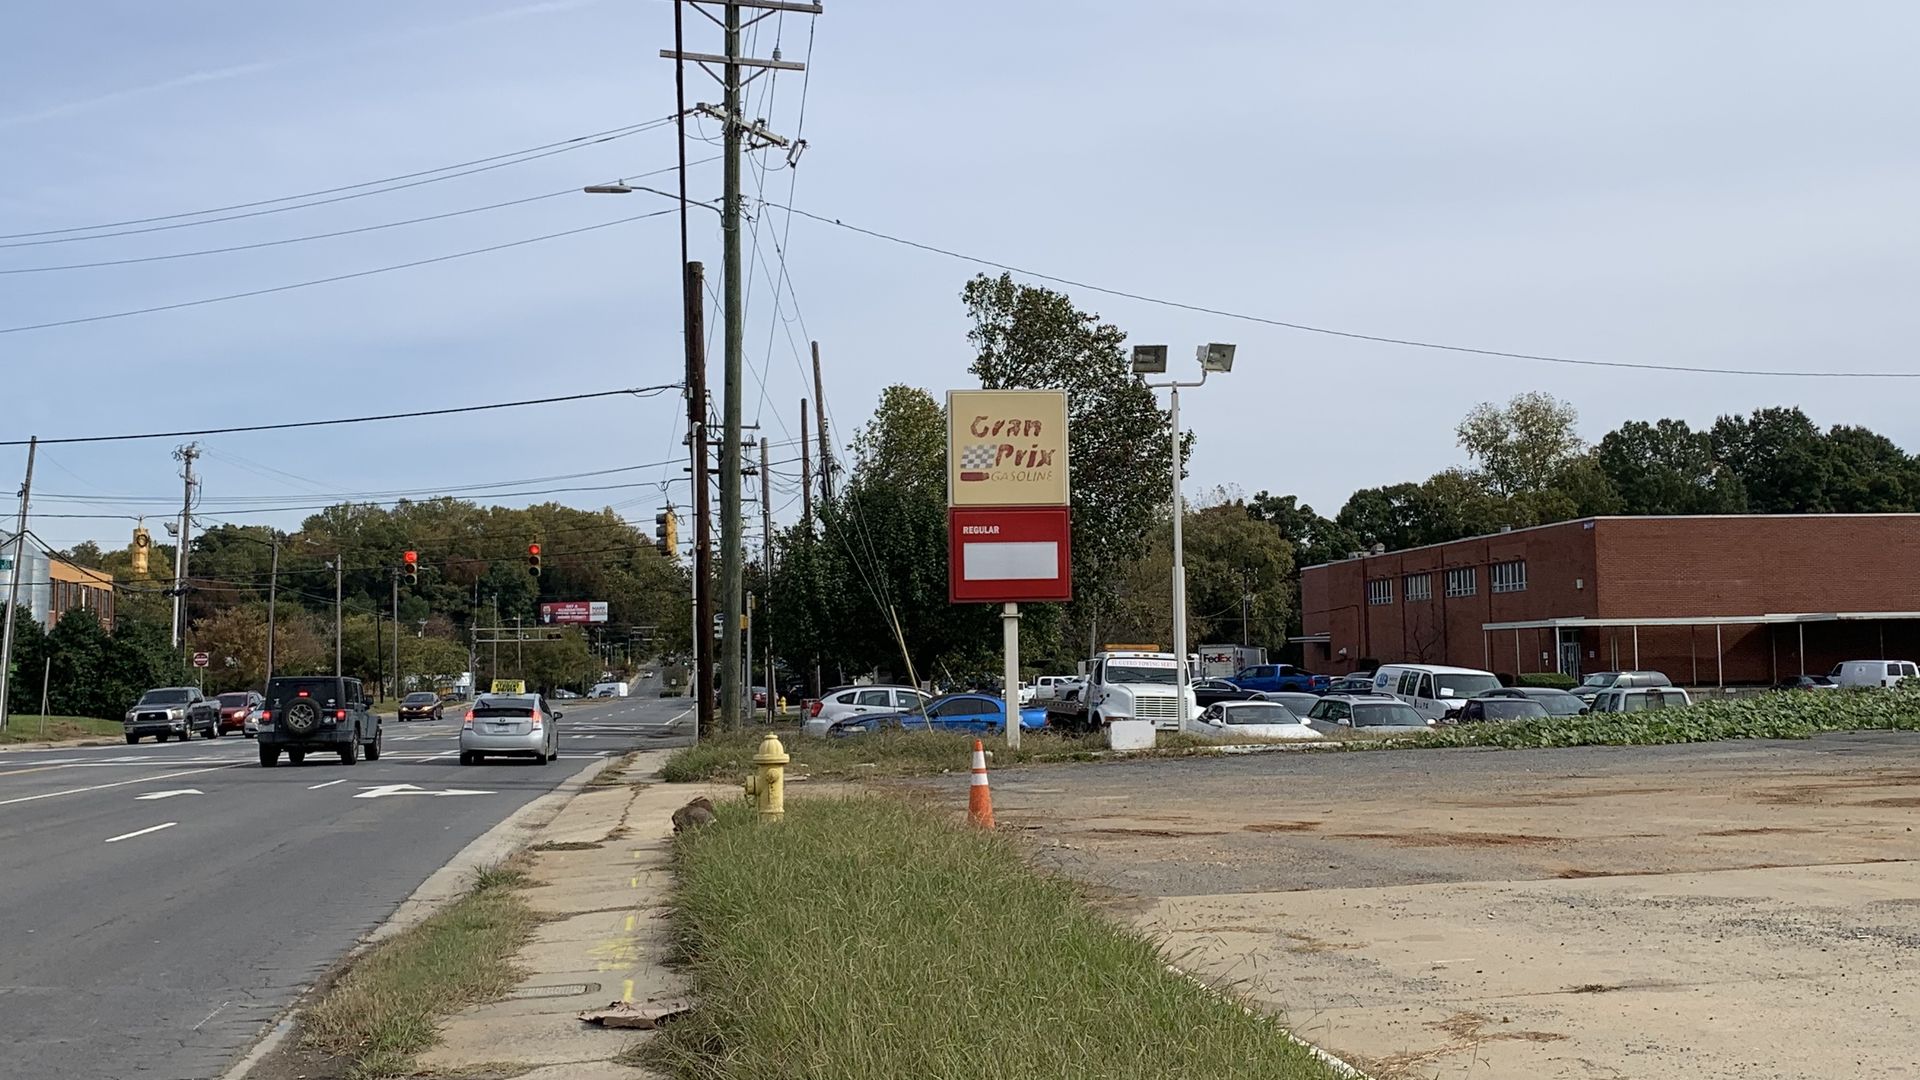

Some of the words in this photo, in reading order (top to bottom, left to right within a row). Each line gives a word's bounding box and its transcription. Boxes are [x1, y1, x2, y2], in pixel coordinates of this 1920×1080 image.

[970, 416, 1042, 438] Gran
[995, 444, 1056, 468] Prix
[991, 470, 1052, 482] GASOLINE
[962, 526, 1000, 535] REGULAR
[1203, 653, 1232, 664] FedEx
